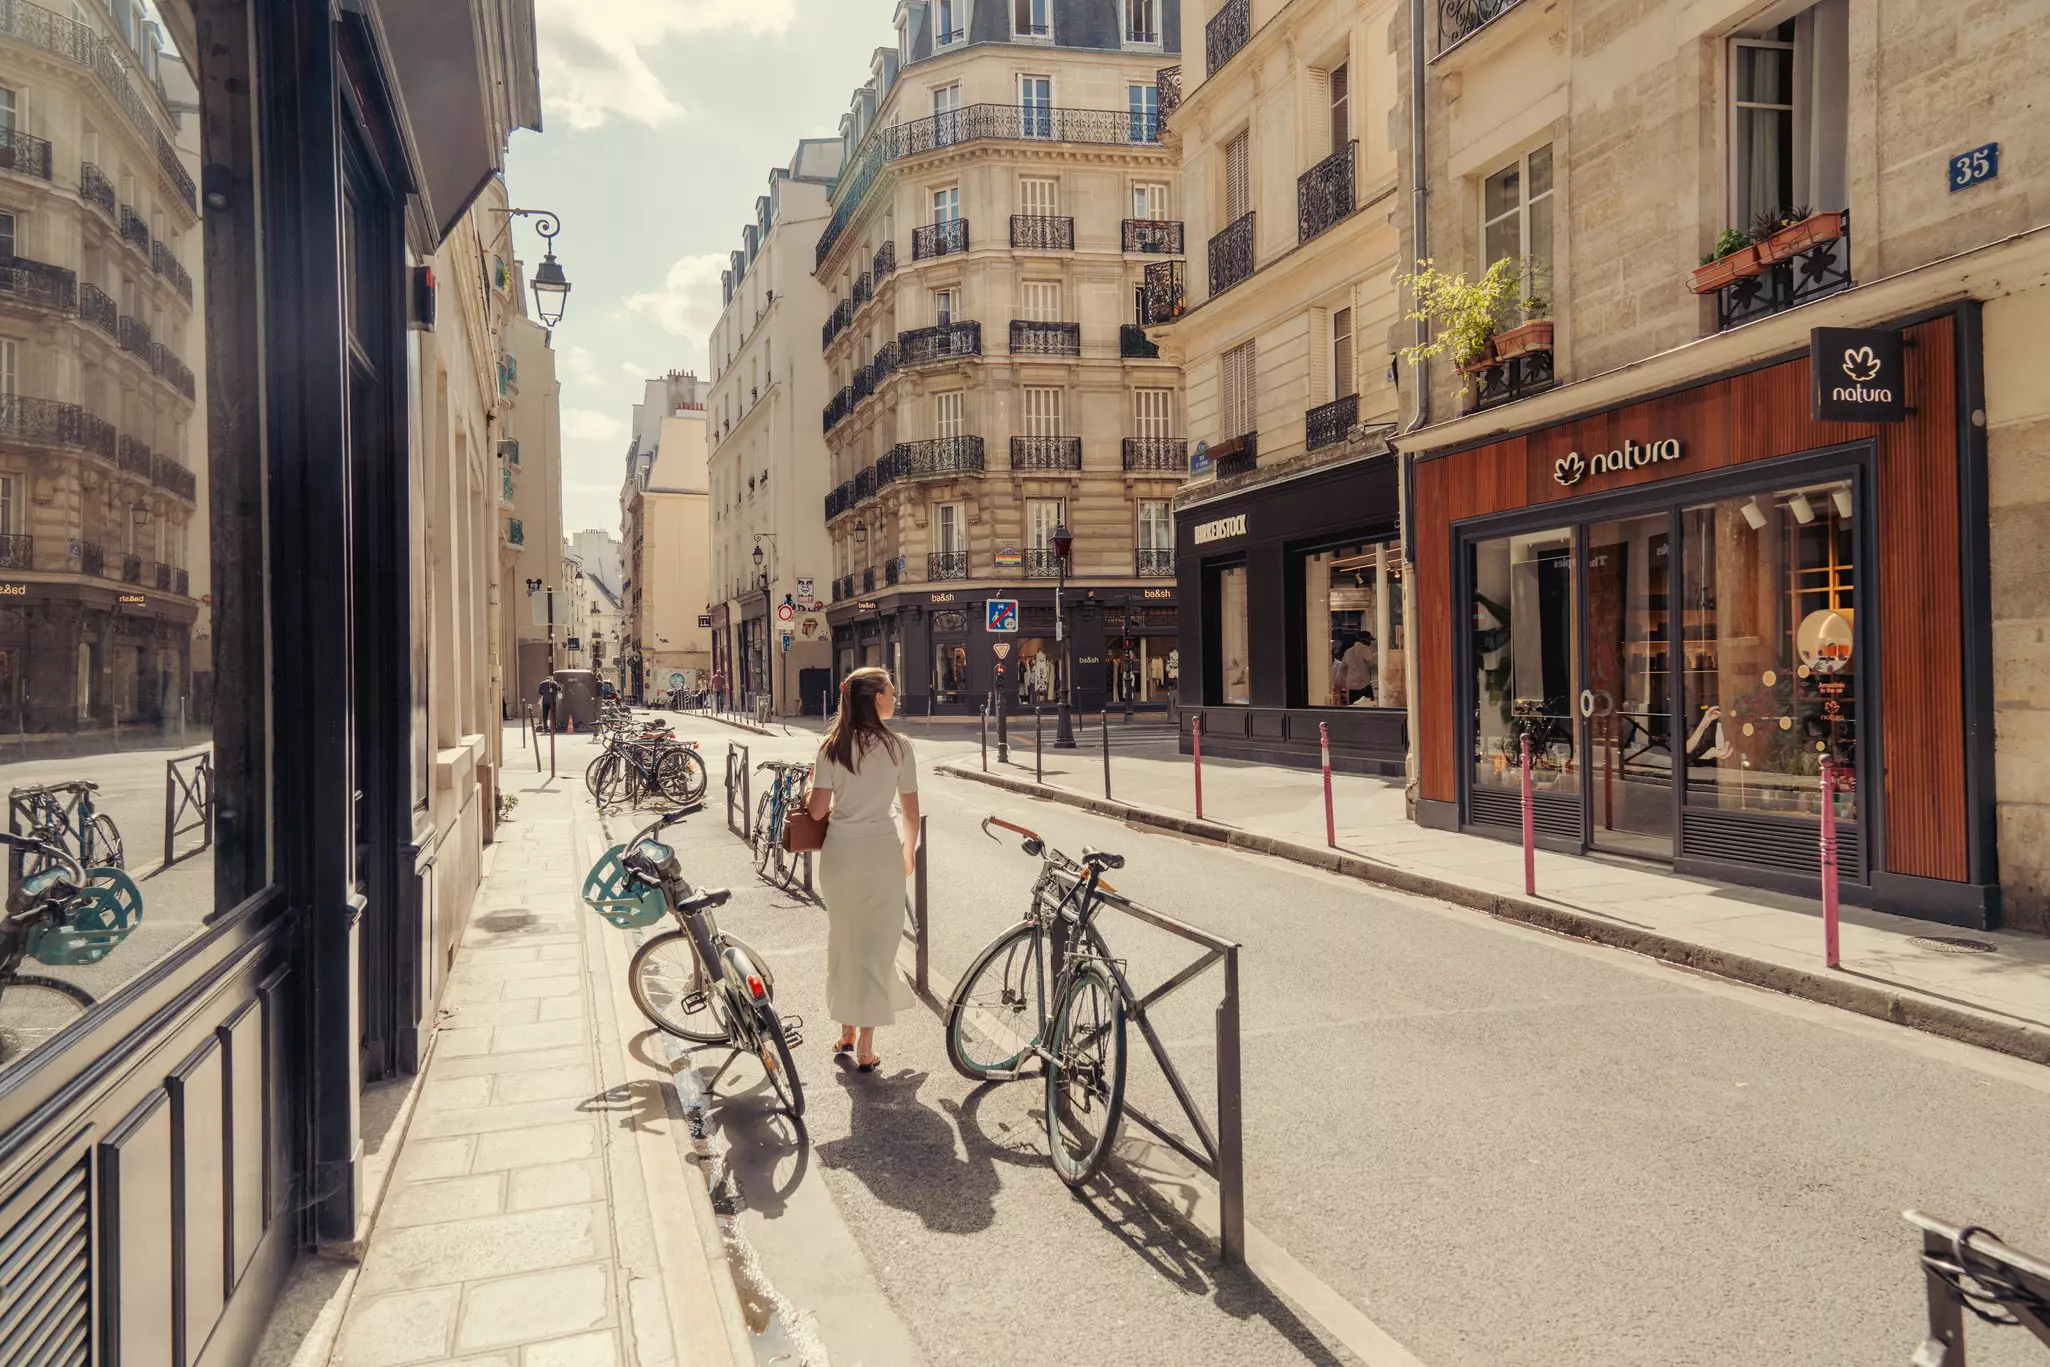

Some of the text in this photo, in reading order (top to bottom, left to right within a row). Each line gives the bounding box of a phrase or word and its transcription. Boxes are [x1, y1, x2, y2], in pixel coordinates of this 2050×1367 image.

[1957, 149, 1990, 184] 35
[1832, 383, 1892, 403] natura
[1590, 438, 1680, 475] natura
[1194, 513, 1247, 545] BIRKENSTOCK
[931, 593, 955, 602] ba&sh
[1144, 589, 1171, 598] ba&sh
